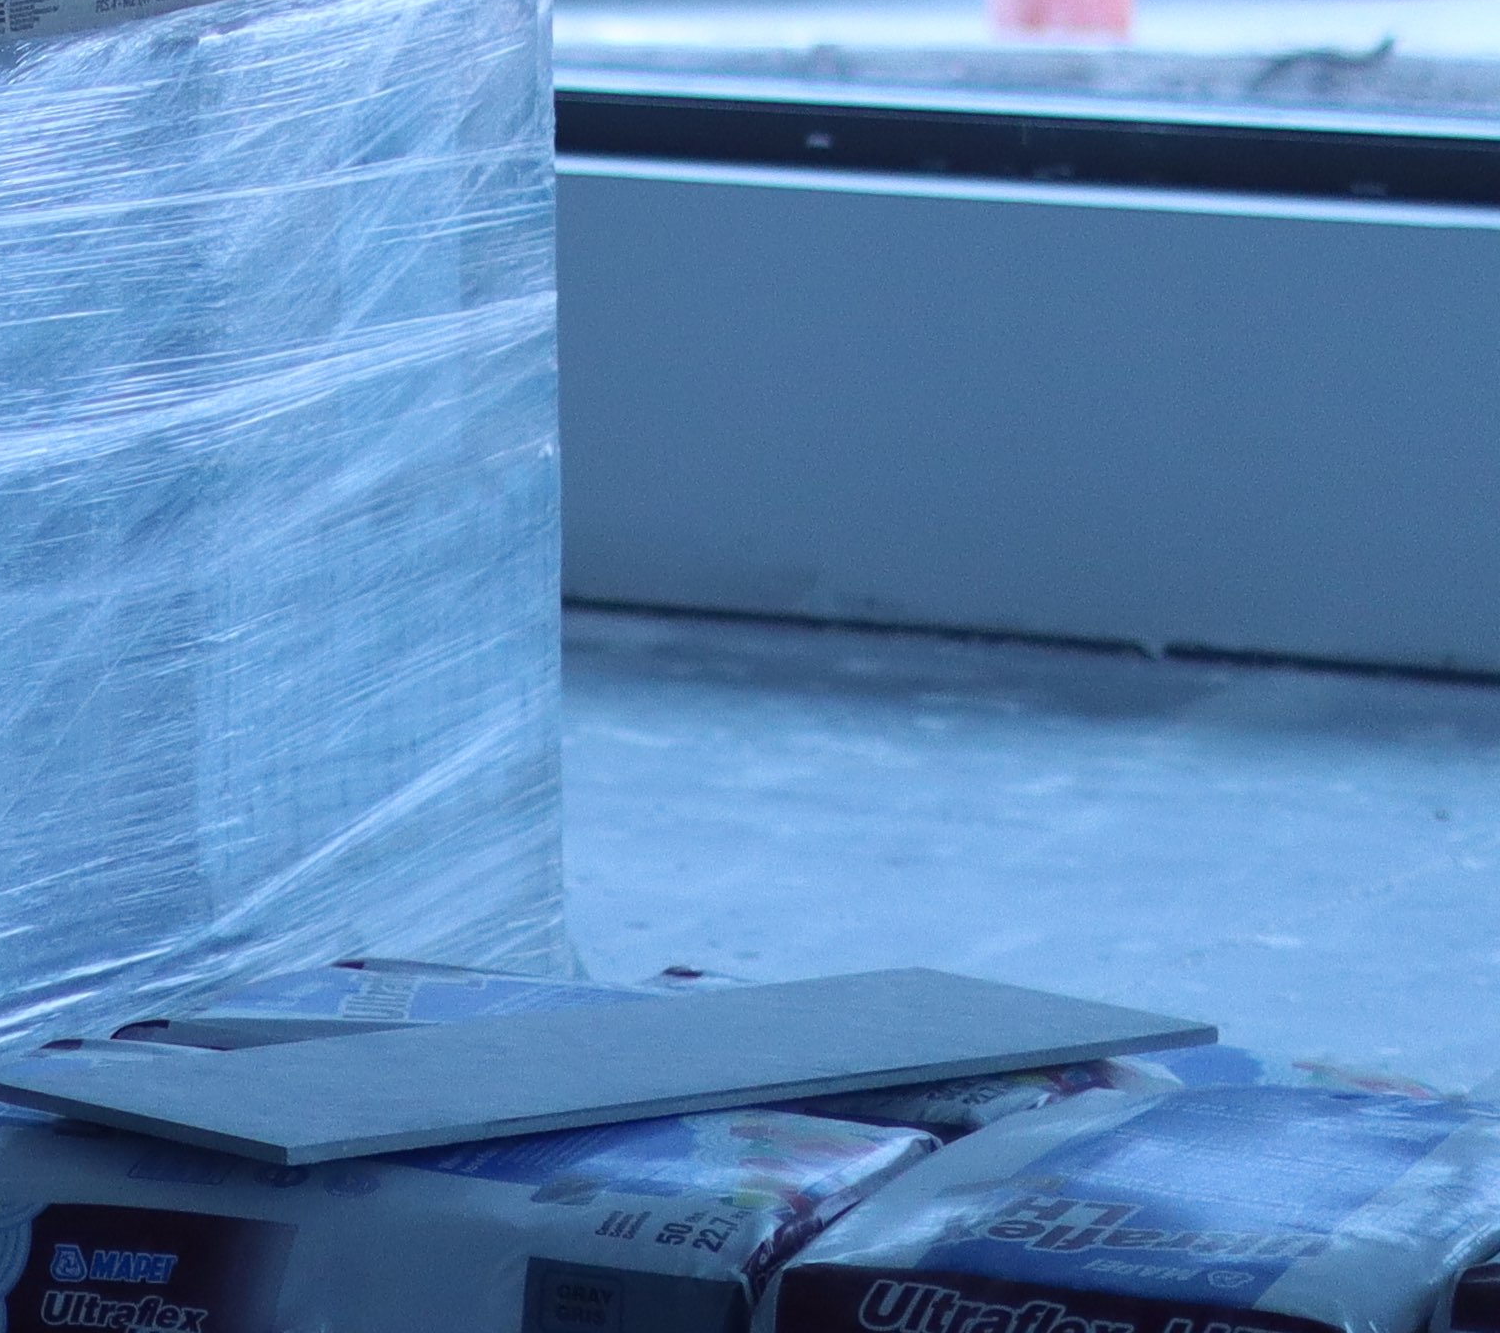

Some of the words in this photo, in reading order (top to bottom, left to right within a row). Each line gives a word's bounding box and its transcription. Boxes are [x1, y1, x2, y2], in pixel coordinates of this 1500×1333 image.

[655, 1221, 694, 1246] 50
[90, 1248, 178, 1284] MAPEI
[40, 1289, 209, 1333] Ultraflex
